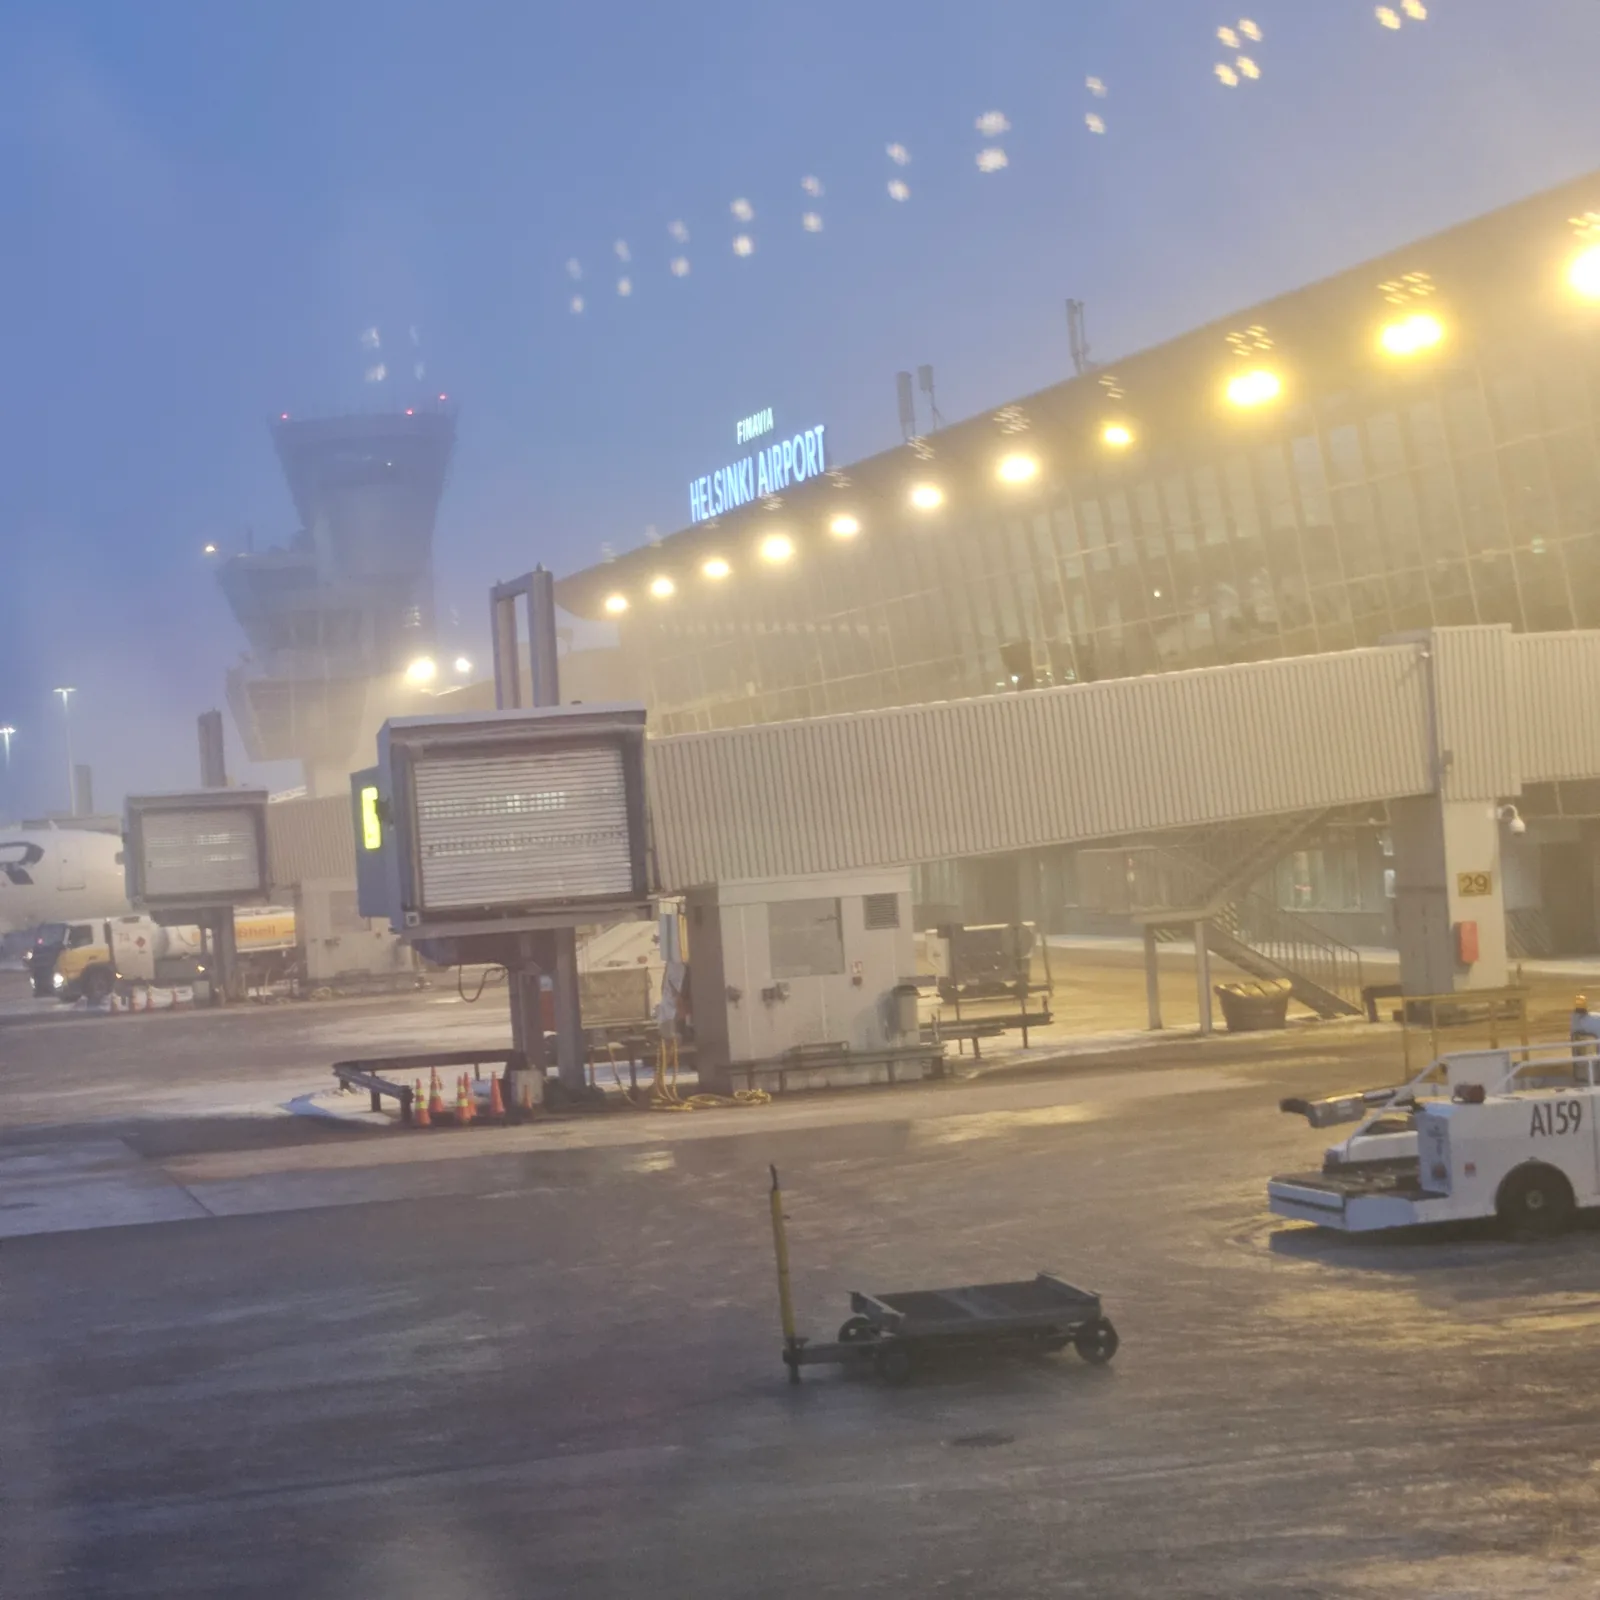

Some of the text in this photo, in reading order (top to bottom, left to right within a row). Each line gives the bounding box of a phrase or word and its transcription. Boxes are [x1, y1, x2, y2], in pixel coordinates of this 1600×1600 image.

[737, 407, 774, 445] FINAVIA
[689, 424, 825, 523] HELSINKI AIRPORT
[1461, 874, 1488, 893] 29
[1530, 1100, 1582, 1137] A159
